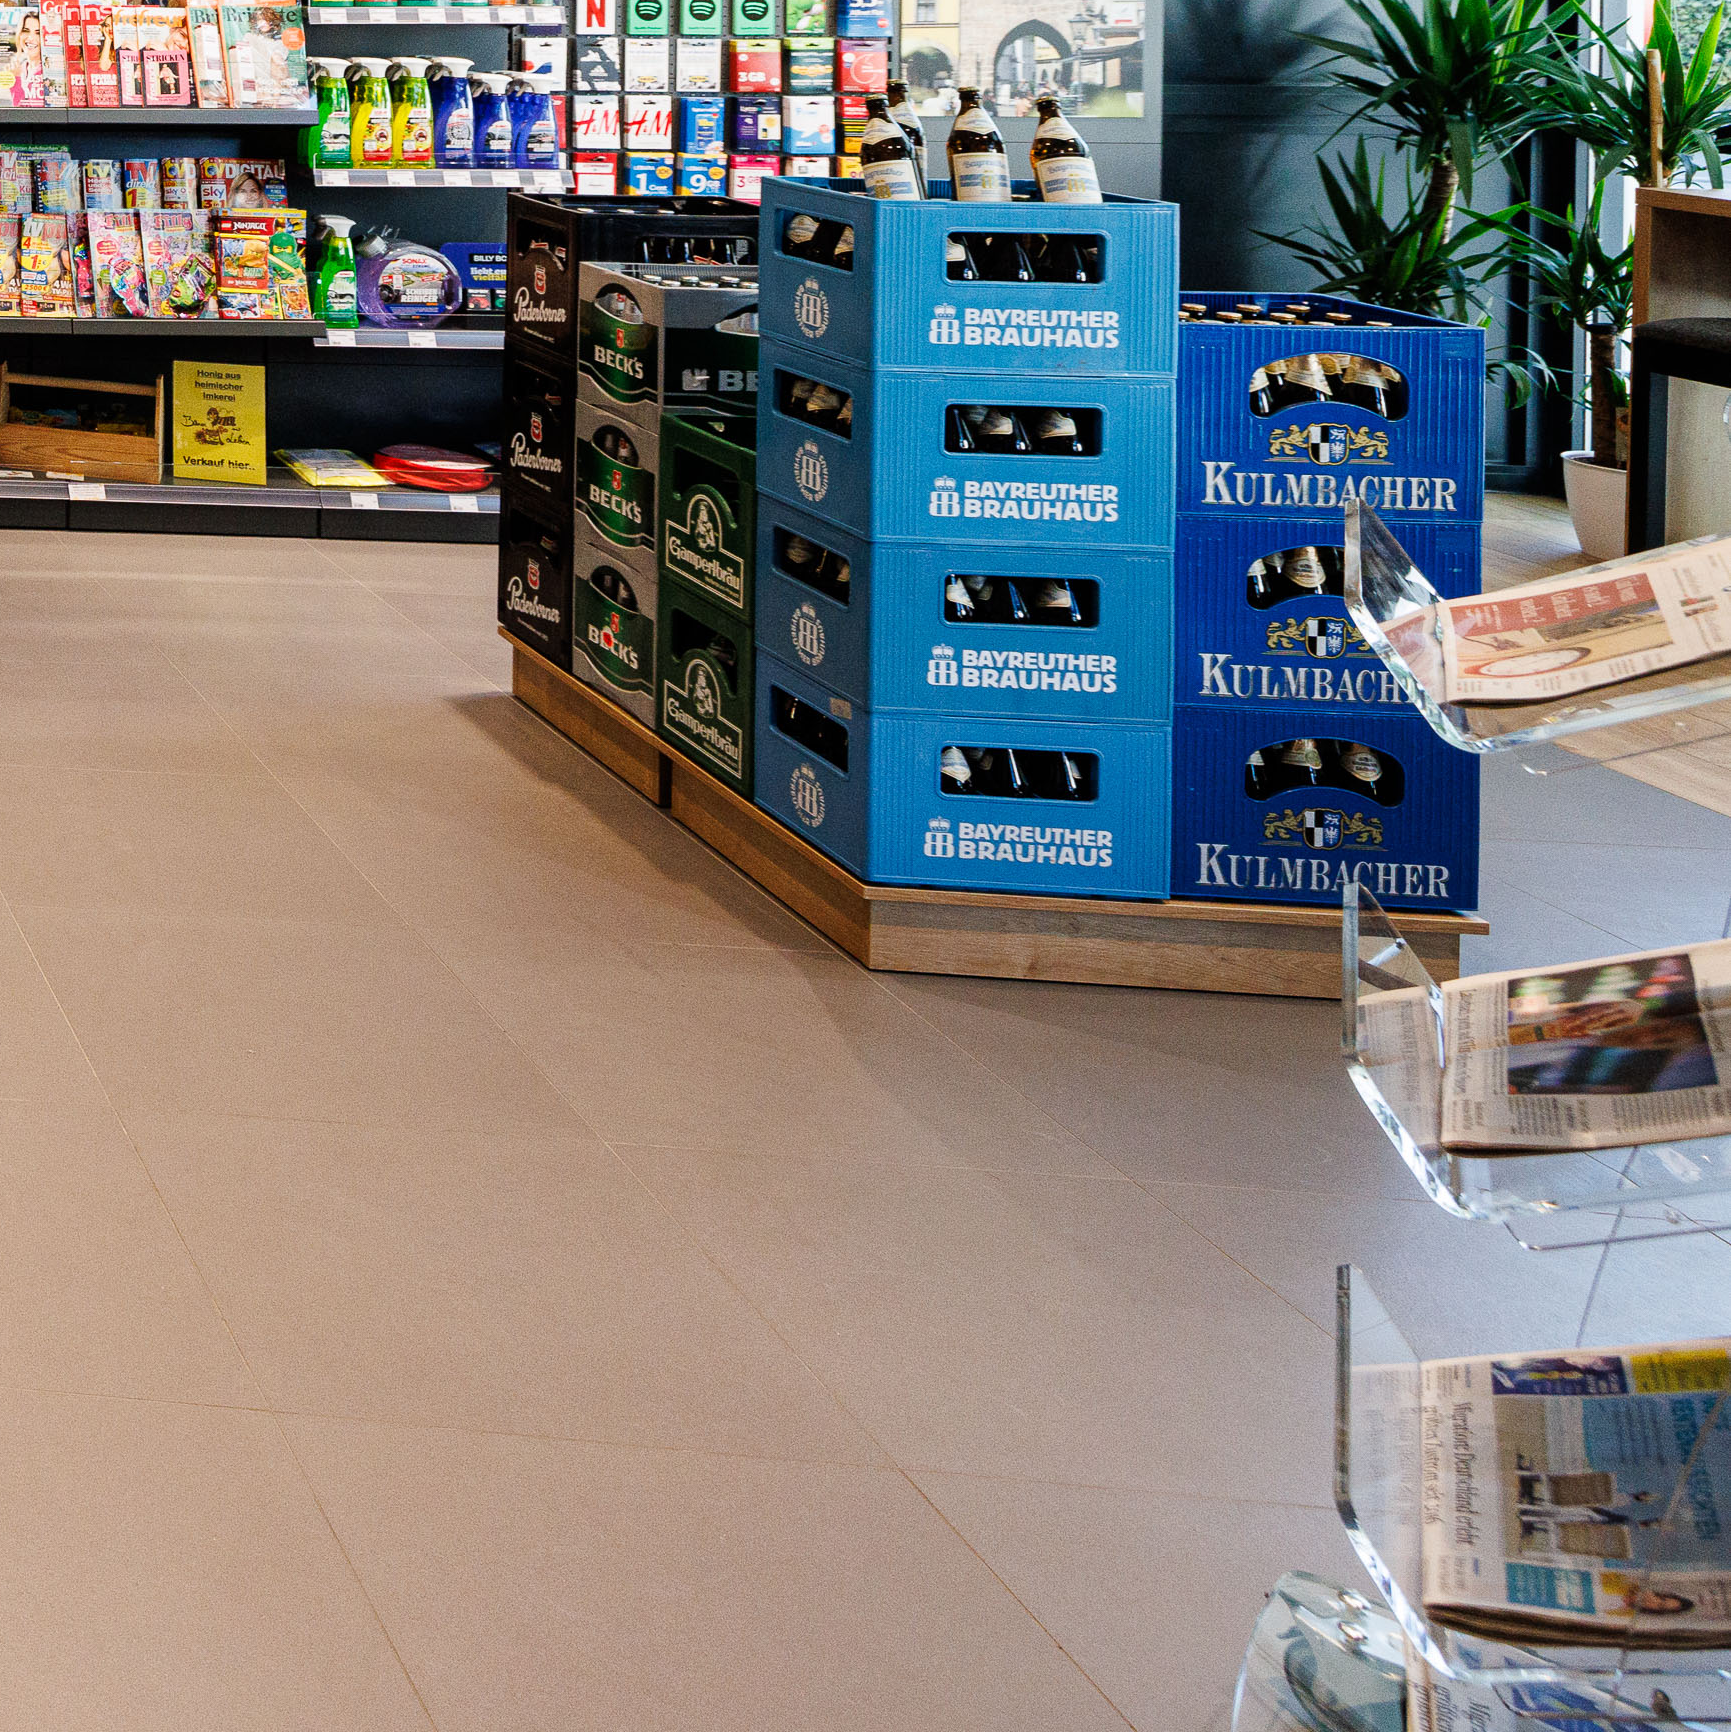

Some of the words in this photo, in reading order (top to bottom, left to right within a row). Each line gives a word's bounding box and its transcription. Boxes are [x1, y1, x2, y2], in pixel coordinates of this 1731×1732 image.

[146, 54, 186, 63] STRICKEN
[574, 108, 620, 137] H&M
[624, 108, 672, 137] H&M
[202, 186, 225, 198] sky
[234, 221, 267, 232] NINJAGO
[514, 287, 567, 323] Paderborner
[964, 308, 1119, 328] BAYREUTHER
[964, 327, 1119, 349] BRAUHAUS
[197, 370, 223, 379] Honig
[594, 345, 643, 380] BECK'S
[195, 381, 244, 390] heimischer
[203, 392, 235, 402] Imkerei
[183, 456, 225, 466] Verkauf
[510, 432, 562, 474] Paderborner
[964, 480, 1118, 501] BAYREUTHER
[1201, 460, 1457, 512] KULMBACHER
[589, 483, 642, 524] BECK'S
[964, 500, 1118, 522] BRAUHAUS
[668, 536, 740, 590] Gamperlbräu
[507, 576, 560, 624] Paderborner
[960, 648, 1117, 671] BAYREUTHER
[959, 670, 1117, 694] BRAUHAUS
[667, 698, 739, 759] Gamperlbräu
[957, 821, 1113, 845] BAYREUTHER
[956, 843, 1113, 867] BRAUHAUS
[1195, 841, 1450, 900] KULMBACHER
